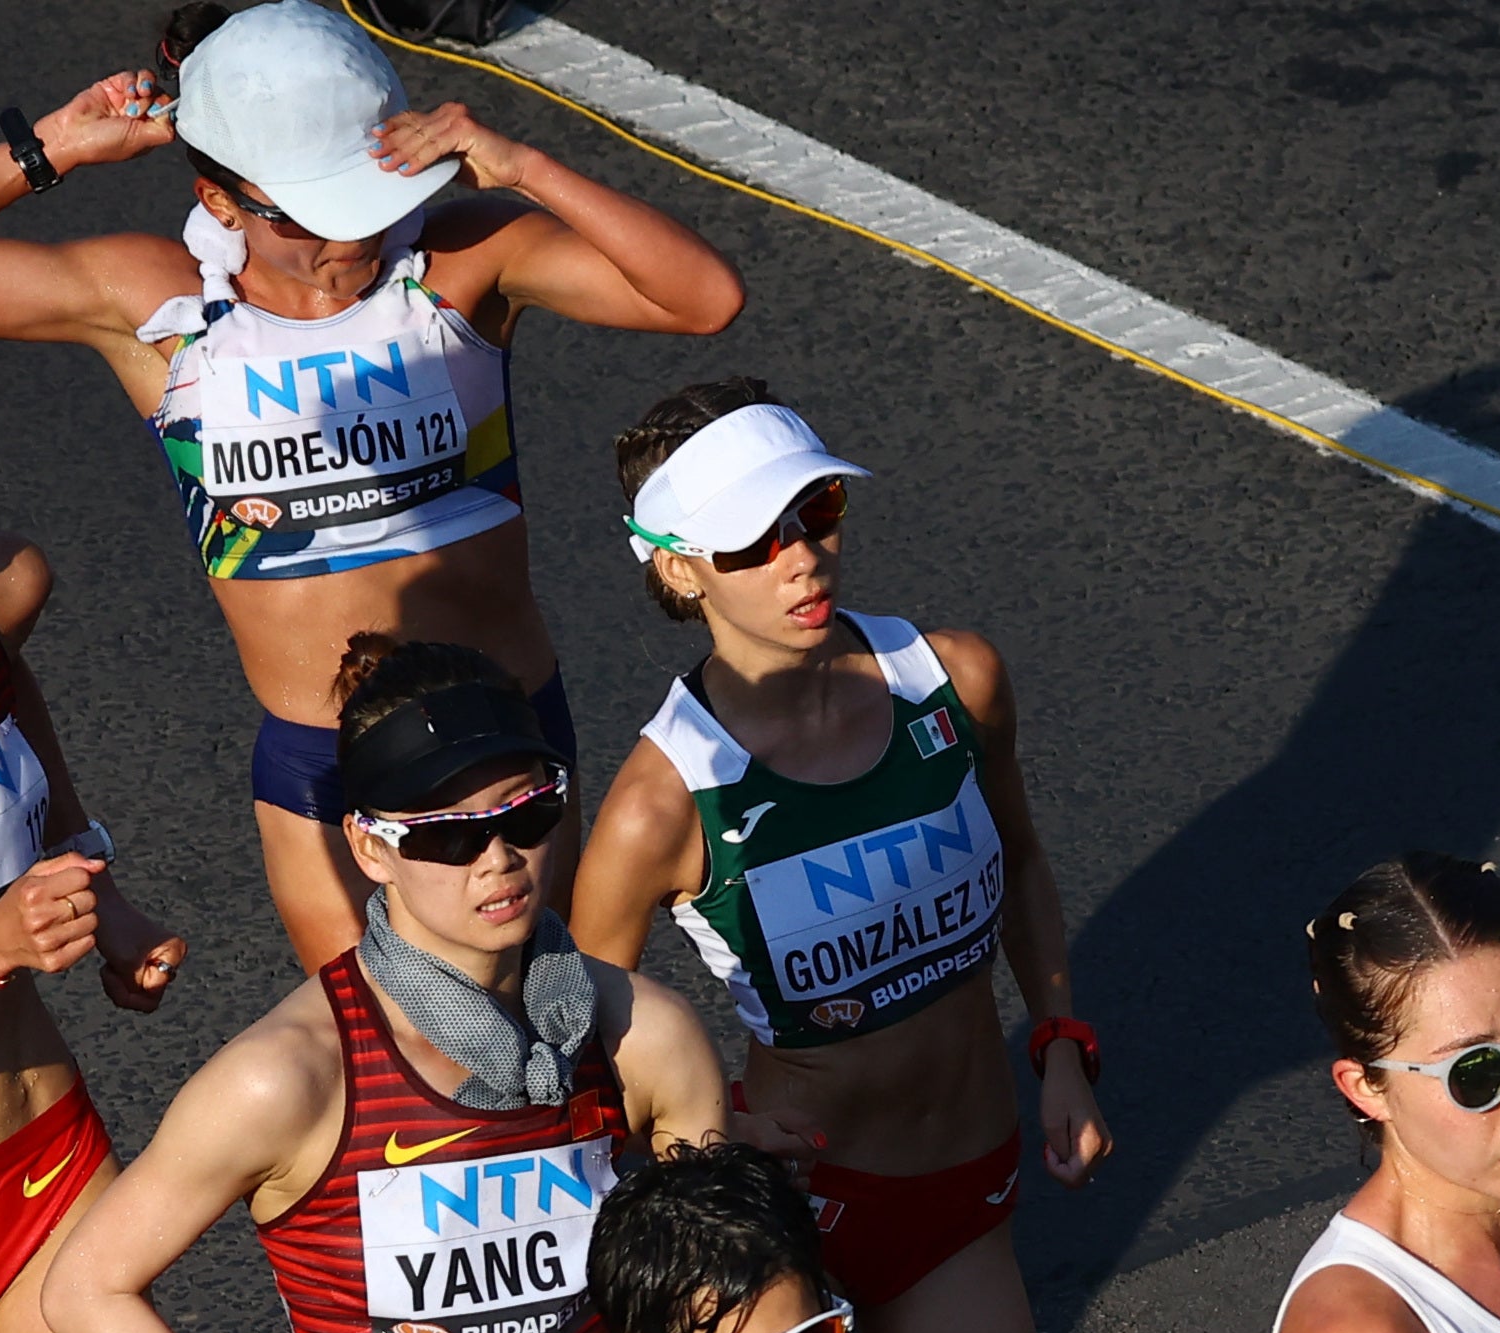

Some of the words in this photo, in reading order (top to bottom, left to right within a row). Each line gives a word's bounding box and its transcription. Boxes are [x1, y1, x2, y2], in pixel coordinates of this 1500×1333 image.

[244, 341, 410, 420] NTN
[212, 413, 407, 485] MOREJÓN
[416, 408, 458, 457] 121
[289, 477, 424, 521] BUDAPEST
[427, 468, 453, 490] 23
[801, 800, 973, 916] NTN
[784, 879, 976, 994] GONZÁLEZ
[978, 851, 1000, 910] 157
[870, 937, 992, 1010] BUDAPEST
[420, 1148, 593, 1236] NTN
[395, 1230, 567, 1312] YANG
